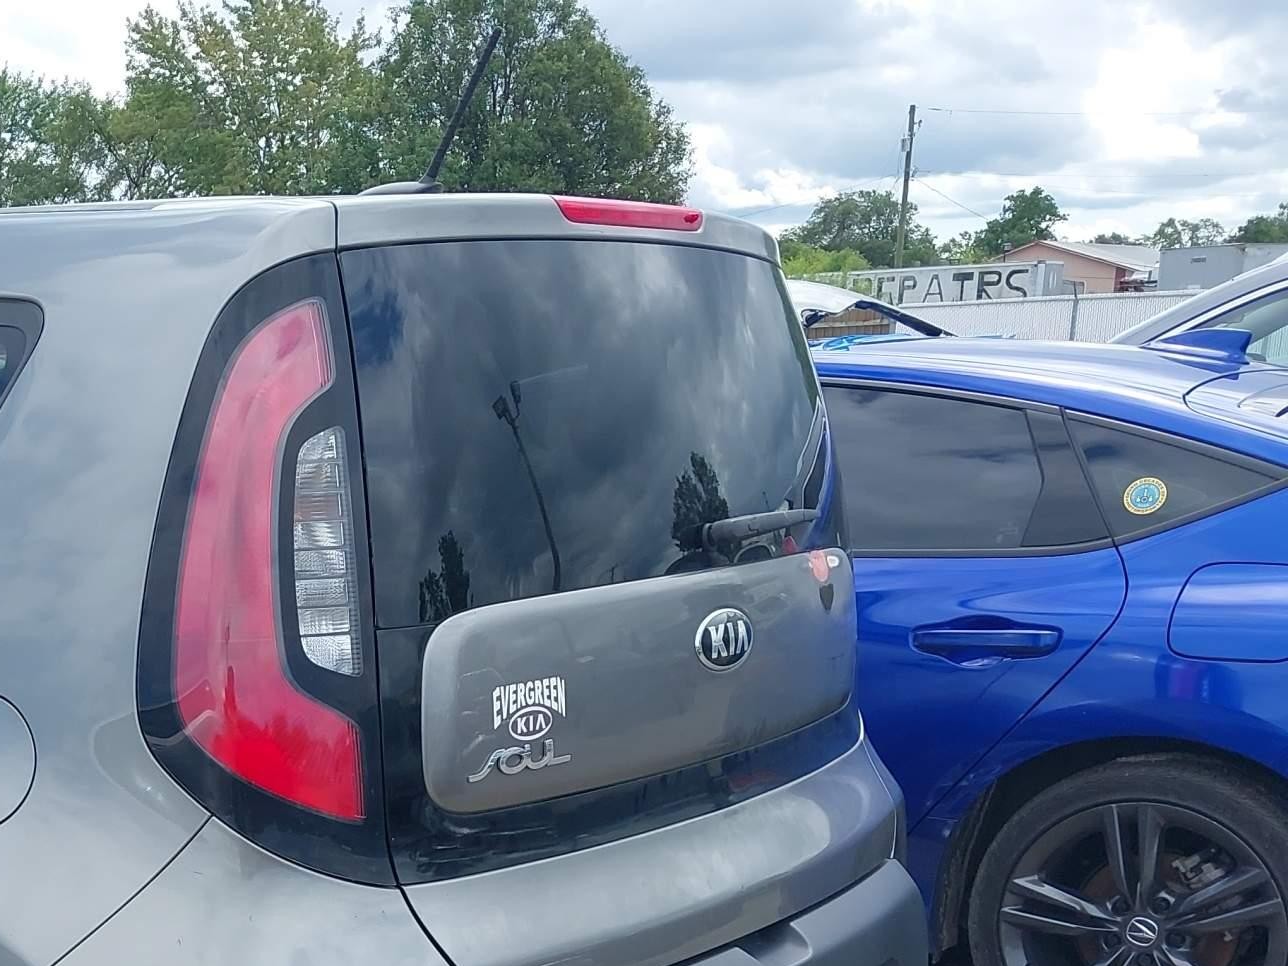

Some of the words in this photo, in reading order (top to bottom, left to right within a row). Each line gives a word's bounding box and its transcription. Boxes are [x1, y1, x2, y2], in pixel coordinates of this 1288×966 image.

[706, 619, 749, 659] KIA
[492, 676, 566, 730] EVERGREEN
[516, 713, 547, 734] KIA
